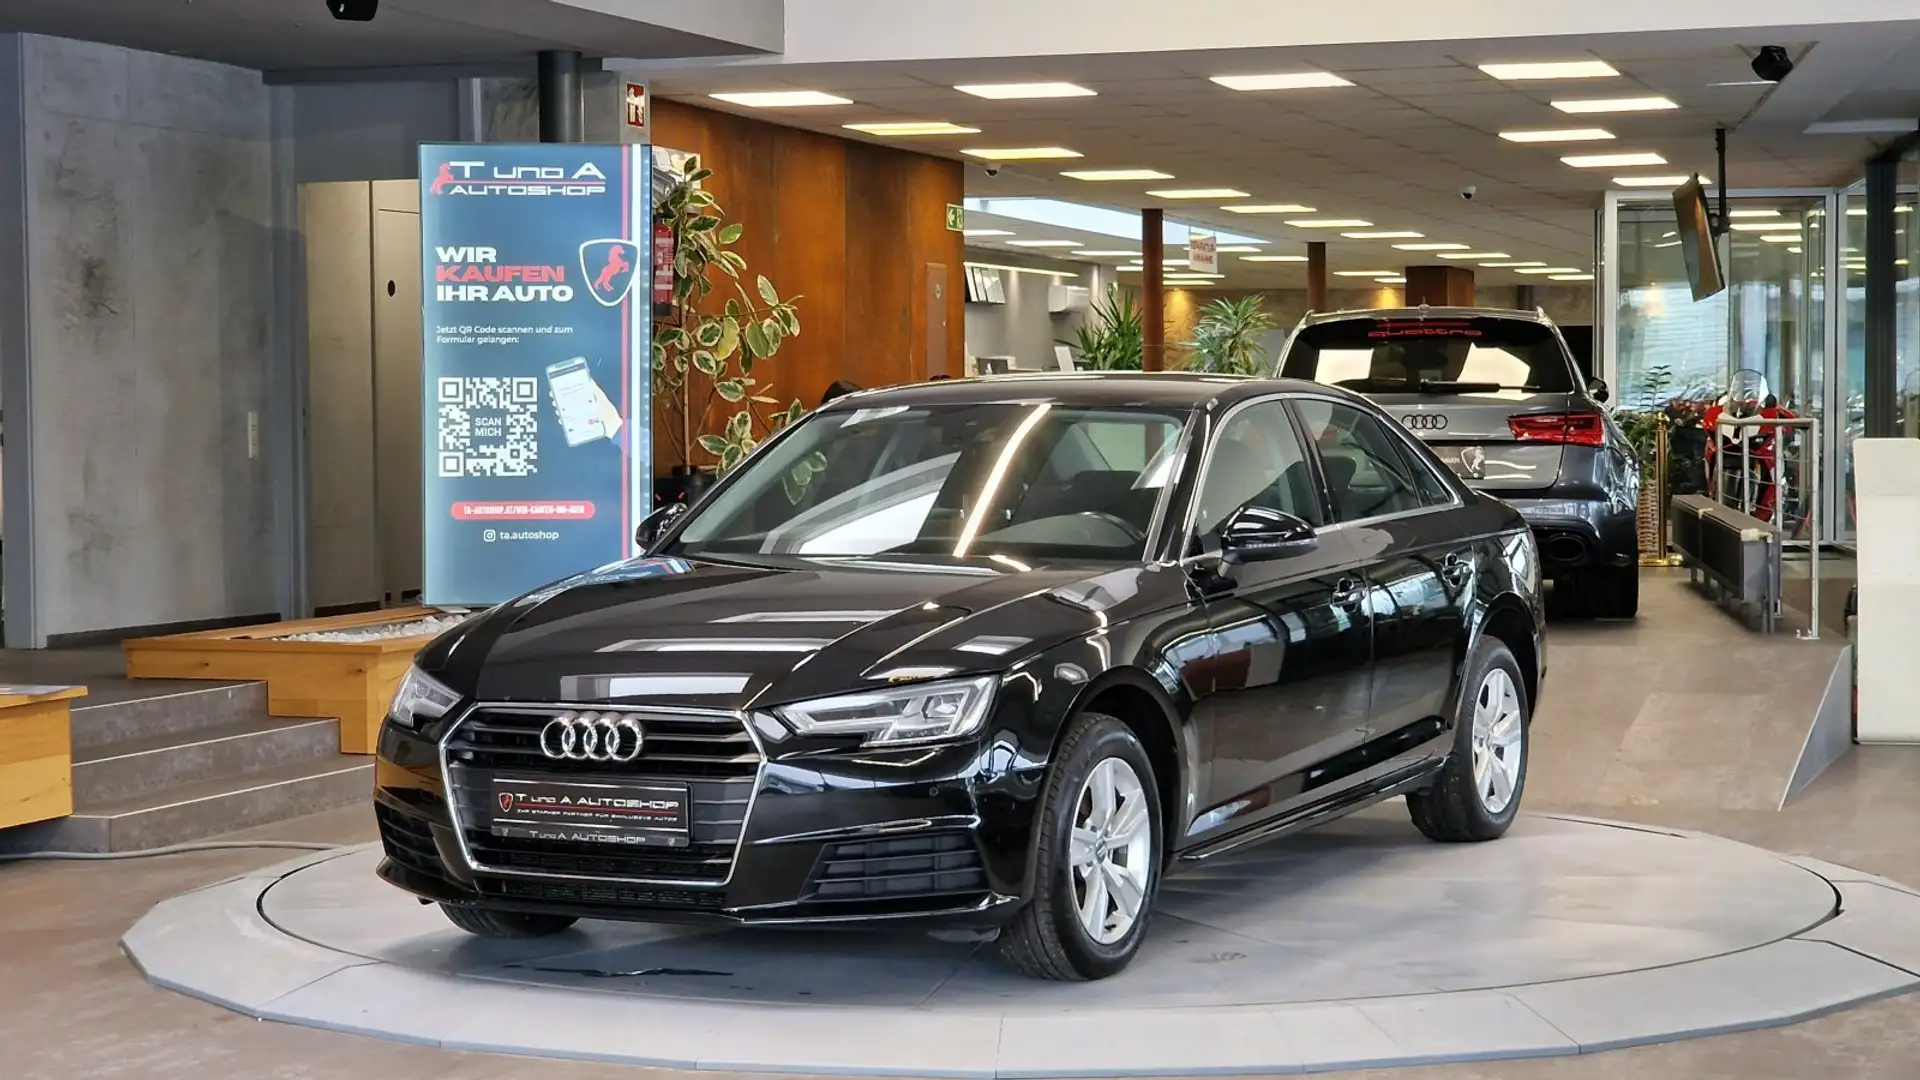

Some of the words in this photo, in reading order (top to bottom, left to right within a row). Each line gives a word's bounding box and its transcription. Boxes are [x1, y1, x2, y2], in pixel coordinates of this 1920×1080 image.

[449, 161, 485, 179] T
[571, 161, 607, 180] A
[449, 185, 606, 196] AUTOSHOP
[435, 246, 497, 263] WIR
[435, 265, 565, 282] KAUFEN
[436, 285, 489, 302] IHR
[491, 285, 574, 302] AUTO
[436, 325, 458, 334] Jetzt
[459, 325, 473, 335] QR
[474, 325, 496, 334] Code
[498, 325, 534, 334] scannen
[536, 325, 553, 334] und
[554, 326, 574, 334] zum
[1368, 328, 1481, 337] quattro
[436, 335, 476, 344] Formular
[477, 335, 520, 346] gelangen:
[474, 417, 502, 427] SCAN
[474, 428, 502, 437] MICH
[499, 530, 560, 541] ta.autoshop
[515, 793, 527, 801] T
[560, 796, 574, 804] A
[576, 796, 679, 809] AUTOSHOP
[529, 830, 538, 838] T
[557, 831, 566, 840] A
[571, 832, 645, 844] AUTOSHOP
